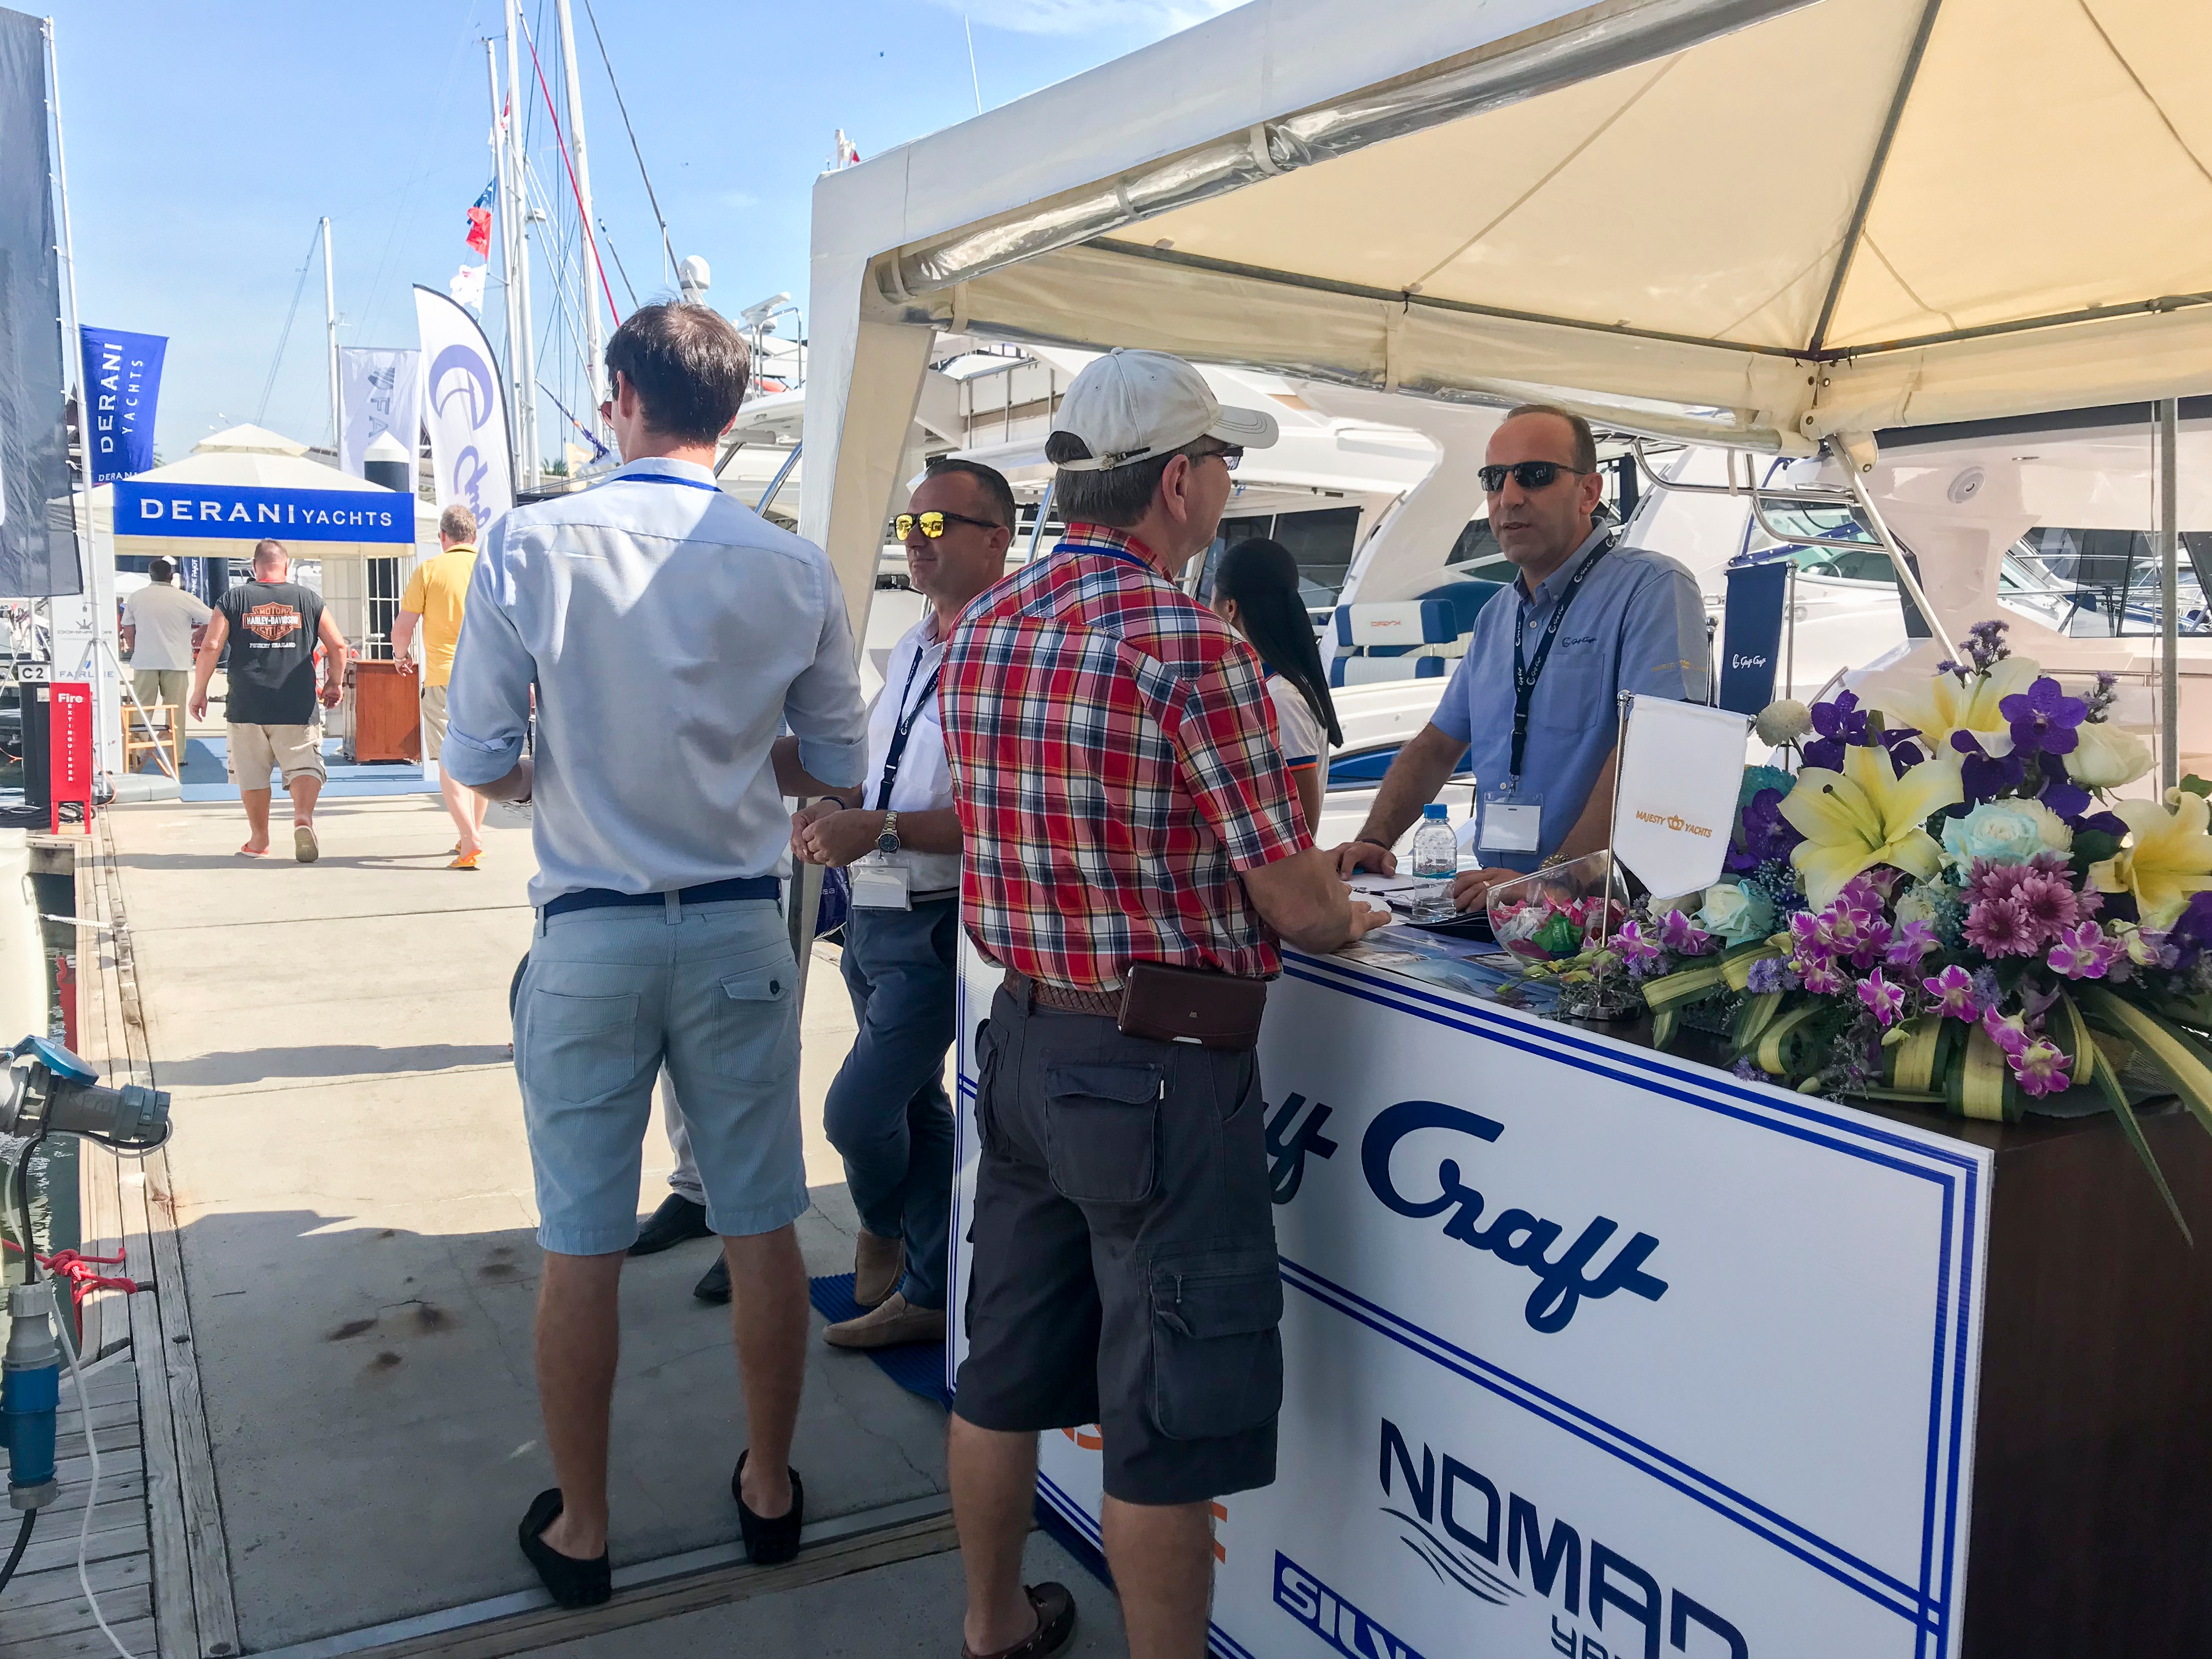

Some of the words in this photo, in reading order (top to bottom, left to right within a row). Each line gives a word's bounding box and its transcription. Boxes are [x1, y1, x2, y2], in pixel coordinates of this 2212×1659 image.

[98, 343, 123, 454] DERANI
[122, 360, 143, 434] YACHTS
[140, 498, 295, 524] DERANI
[302, 509, 392, 526] YACHTS
[246, 615, 299, 625] HARLEY-DAVIDSON
[58, 693, 83, 703] Fire
[1636, 810, 1666, 825] MAJESTY
[1685, 823, 1713, 838] YACHTS
[1361, 1100, 1669, 1334] Craft
